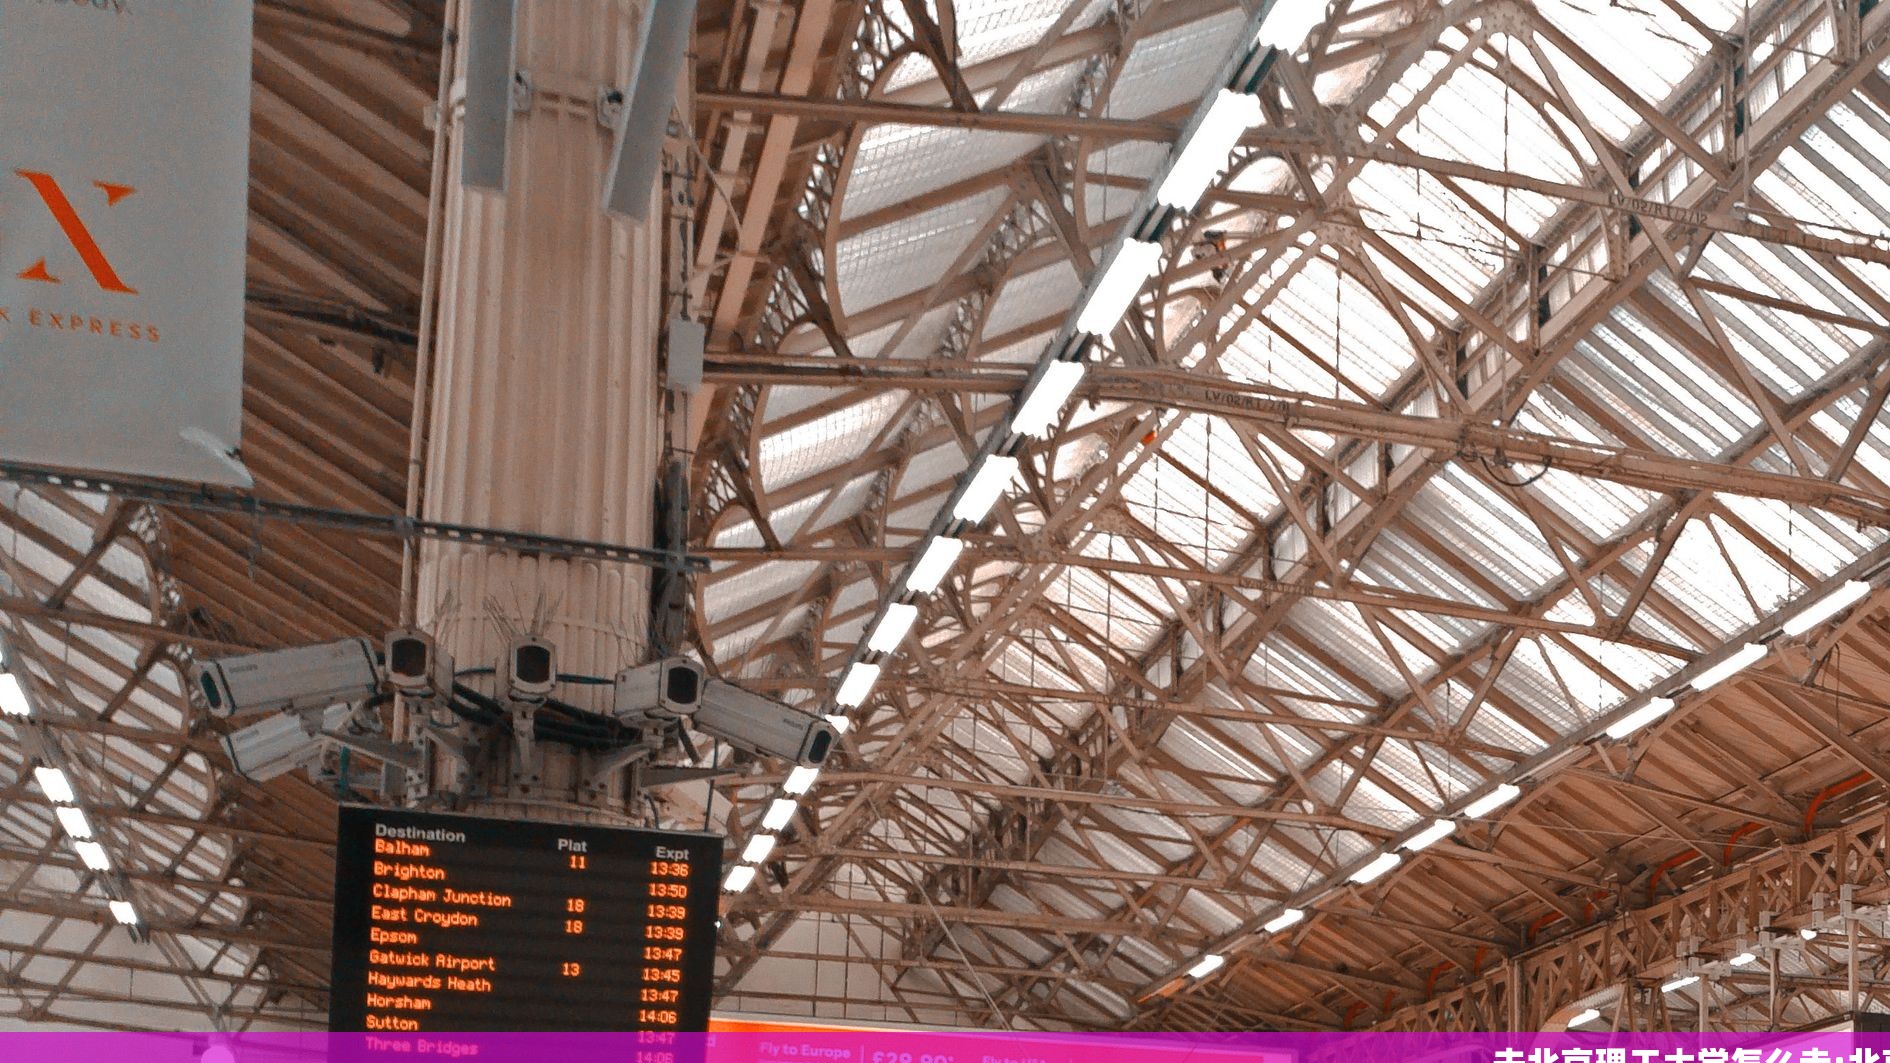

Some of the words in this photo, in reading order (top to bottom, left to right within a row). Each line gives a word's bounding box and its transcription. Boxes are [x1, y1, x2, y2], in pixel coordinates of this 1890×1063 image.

[0, 168, 139, 296] X
[29, 308, 160, 343] EXPRESS
[375, 823, 466, 843] Destination
[558, 838, 587, 853] Plat
[656, 845, 690, 861] Expt
[375, 839, 430, 857] Balham
[569, 855, 587, 869] 11
[373, 861, 445, 880] Brighton
[648, 882, 687, 898] 13:50
[372, 883, 436, 902] Clapham
[443, 888, 512, 907] Junction
[371, 905, 408, 922] East
[414, 907, 478, 927] Croydon
[370, 927, 417, 945] Epsom
[643, 947, 682, 961] 13:47
[369, 949, 429, 967] Gatwick
[436, 953, 496, 972] Airport
[562, 962, 580, 976] 13
[367, 971, 441, 991] Haywards
[448, 974, 492, 993] Heath
[366, 993, 431, 1011] Horsham
[366, 1014, 418, 1031] Sutton
[365, 1036, 411, 1053] Three
[417, 1039, 479, 1058] Bridges
[759, 1042, 780, 1057] Fly
[783, 1043, 798, 1056] to
[801, 1045, 851, 1061] Europe
